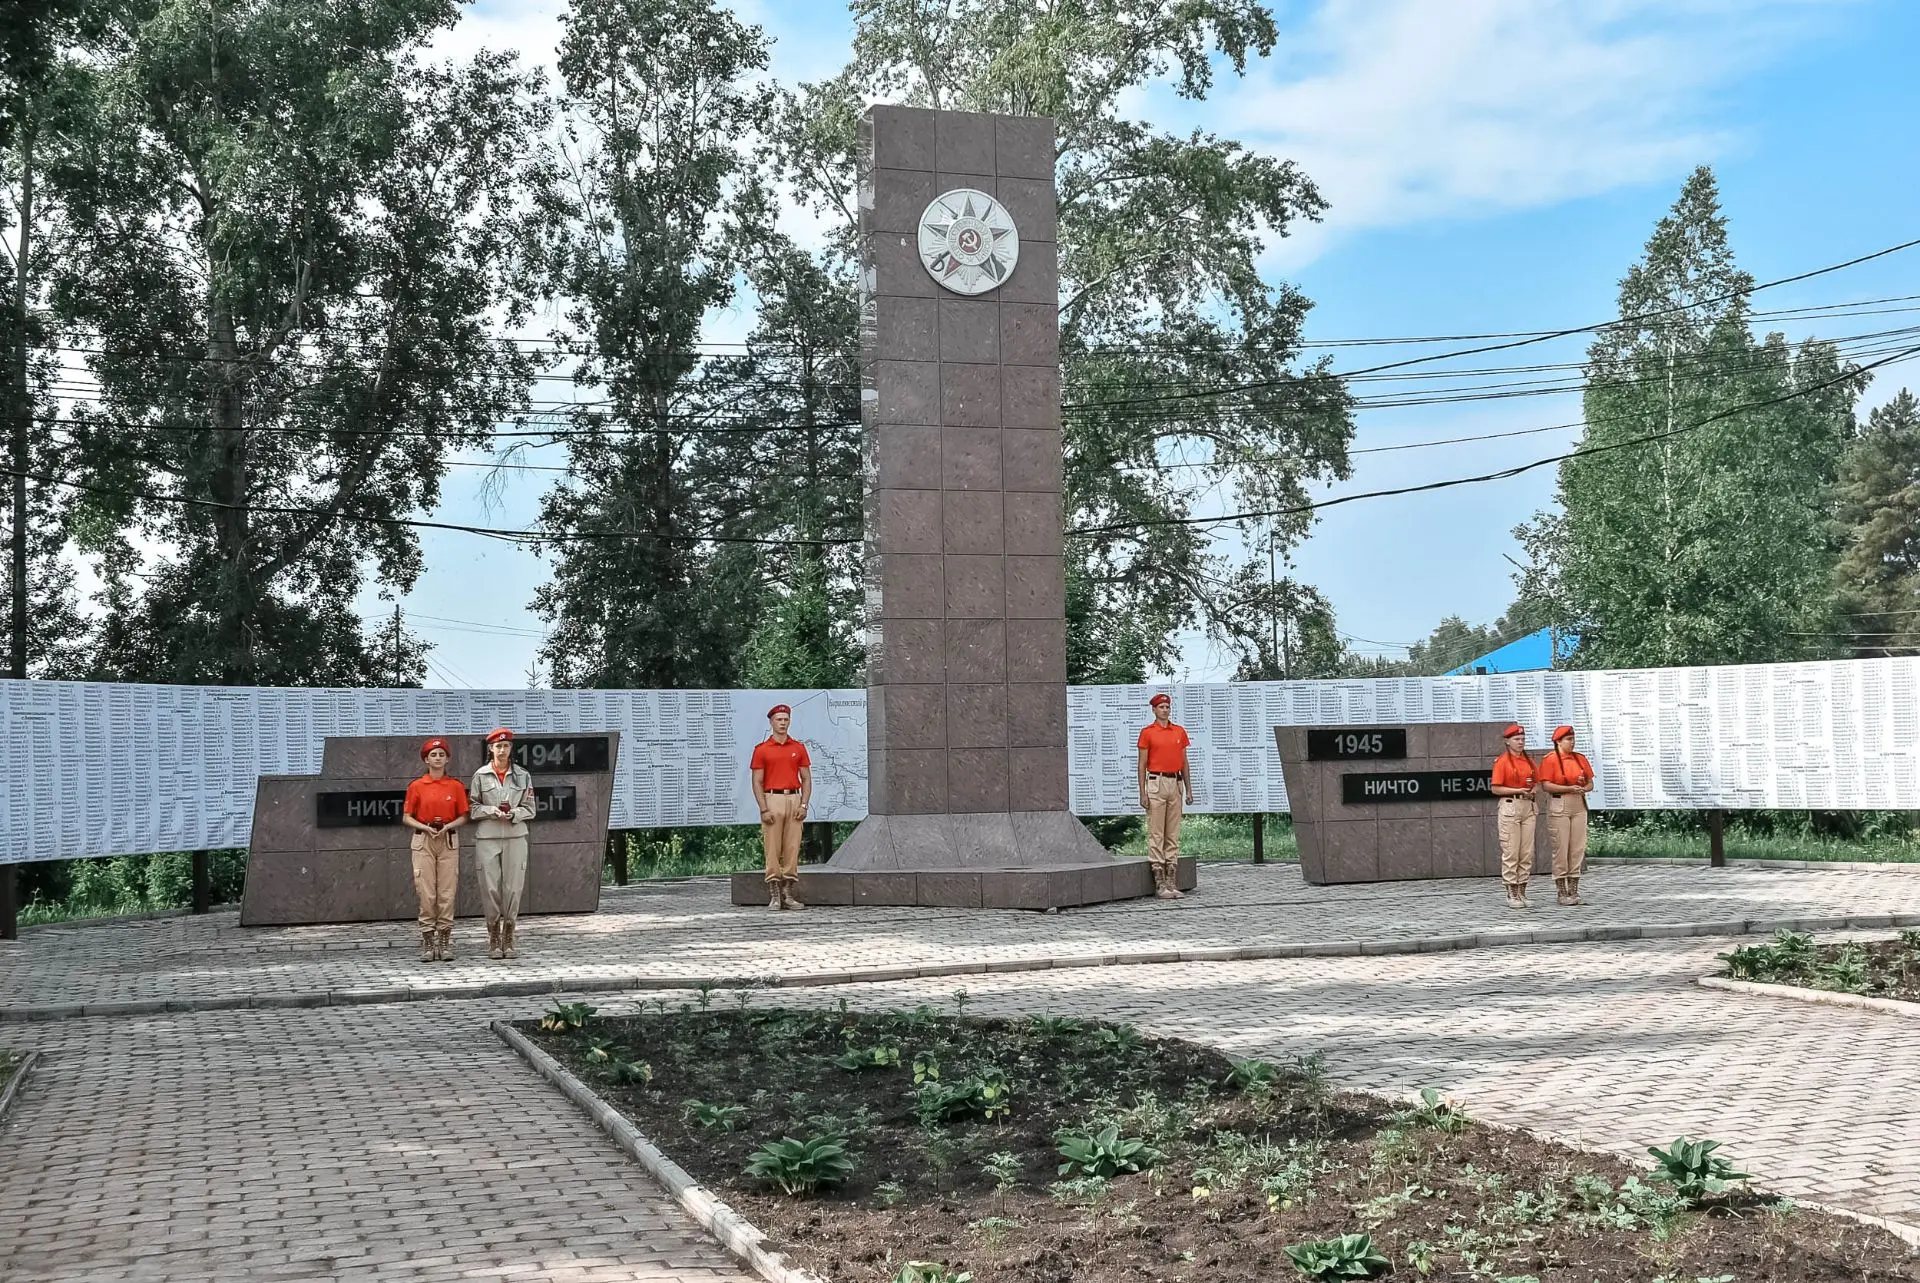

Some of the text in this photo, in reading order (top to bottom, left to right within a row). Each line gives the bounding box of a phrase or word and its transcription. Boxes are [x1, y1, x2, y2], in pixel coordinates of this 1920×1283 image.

[1335, 734, 1383, 753] 1945
[517, 743, 575, 766] 1941
[1364, 779, 1419, 795] НИЧТО
[1441, 778, 1462, 792] НЕ
[347, 799, 404, 817] НИКТ
